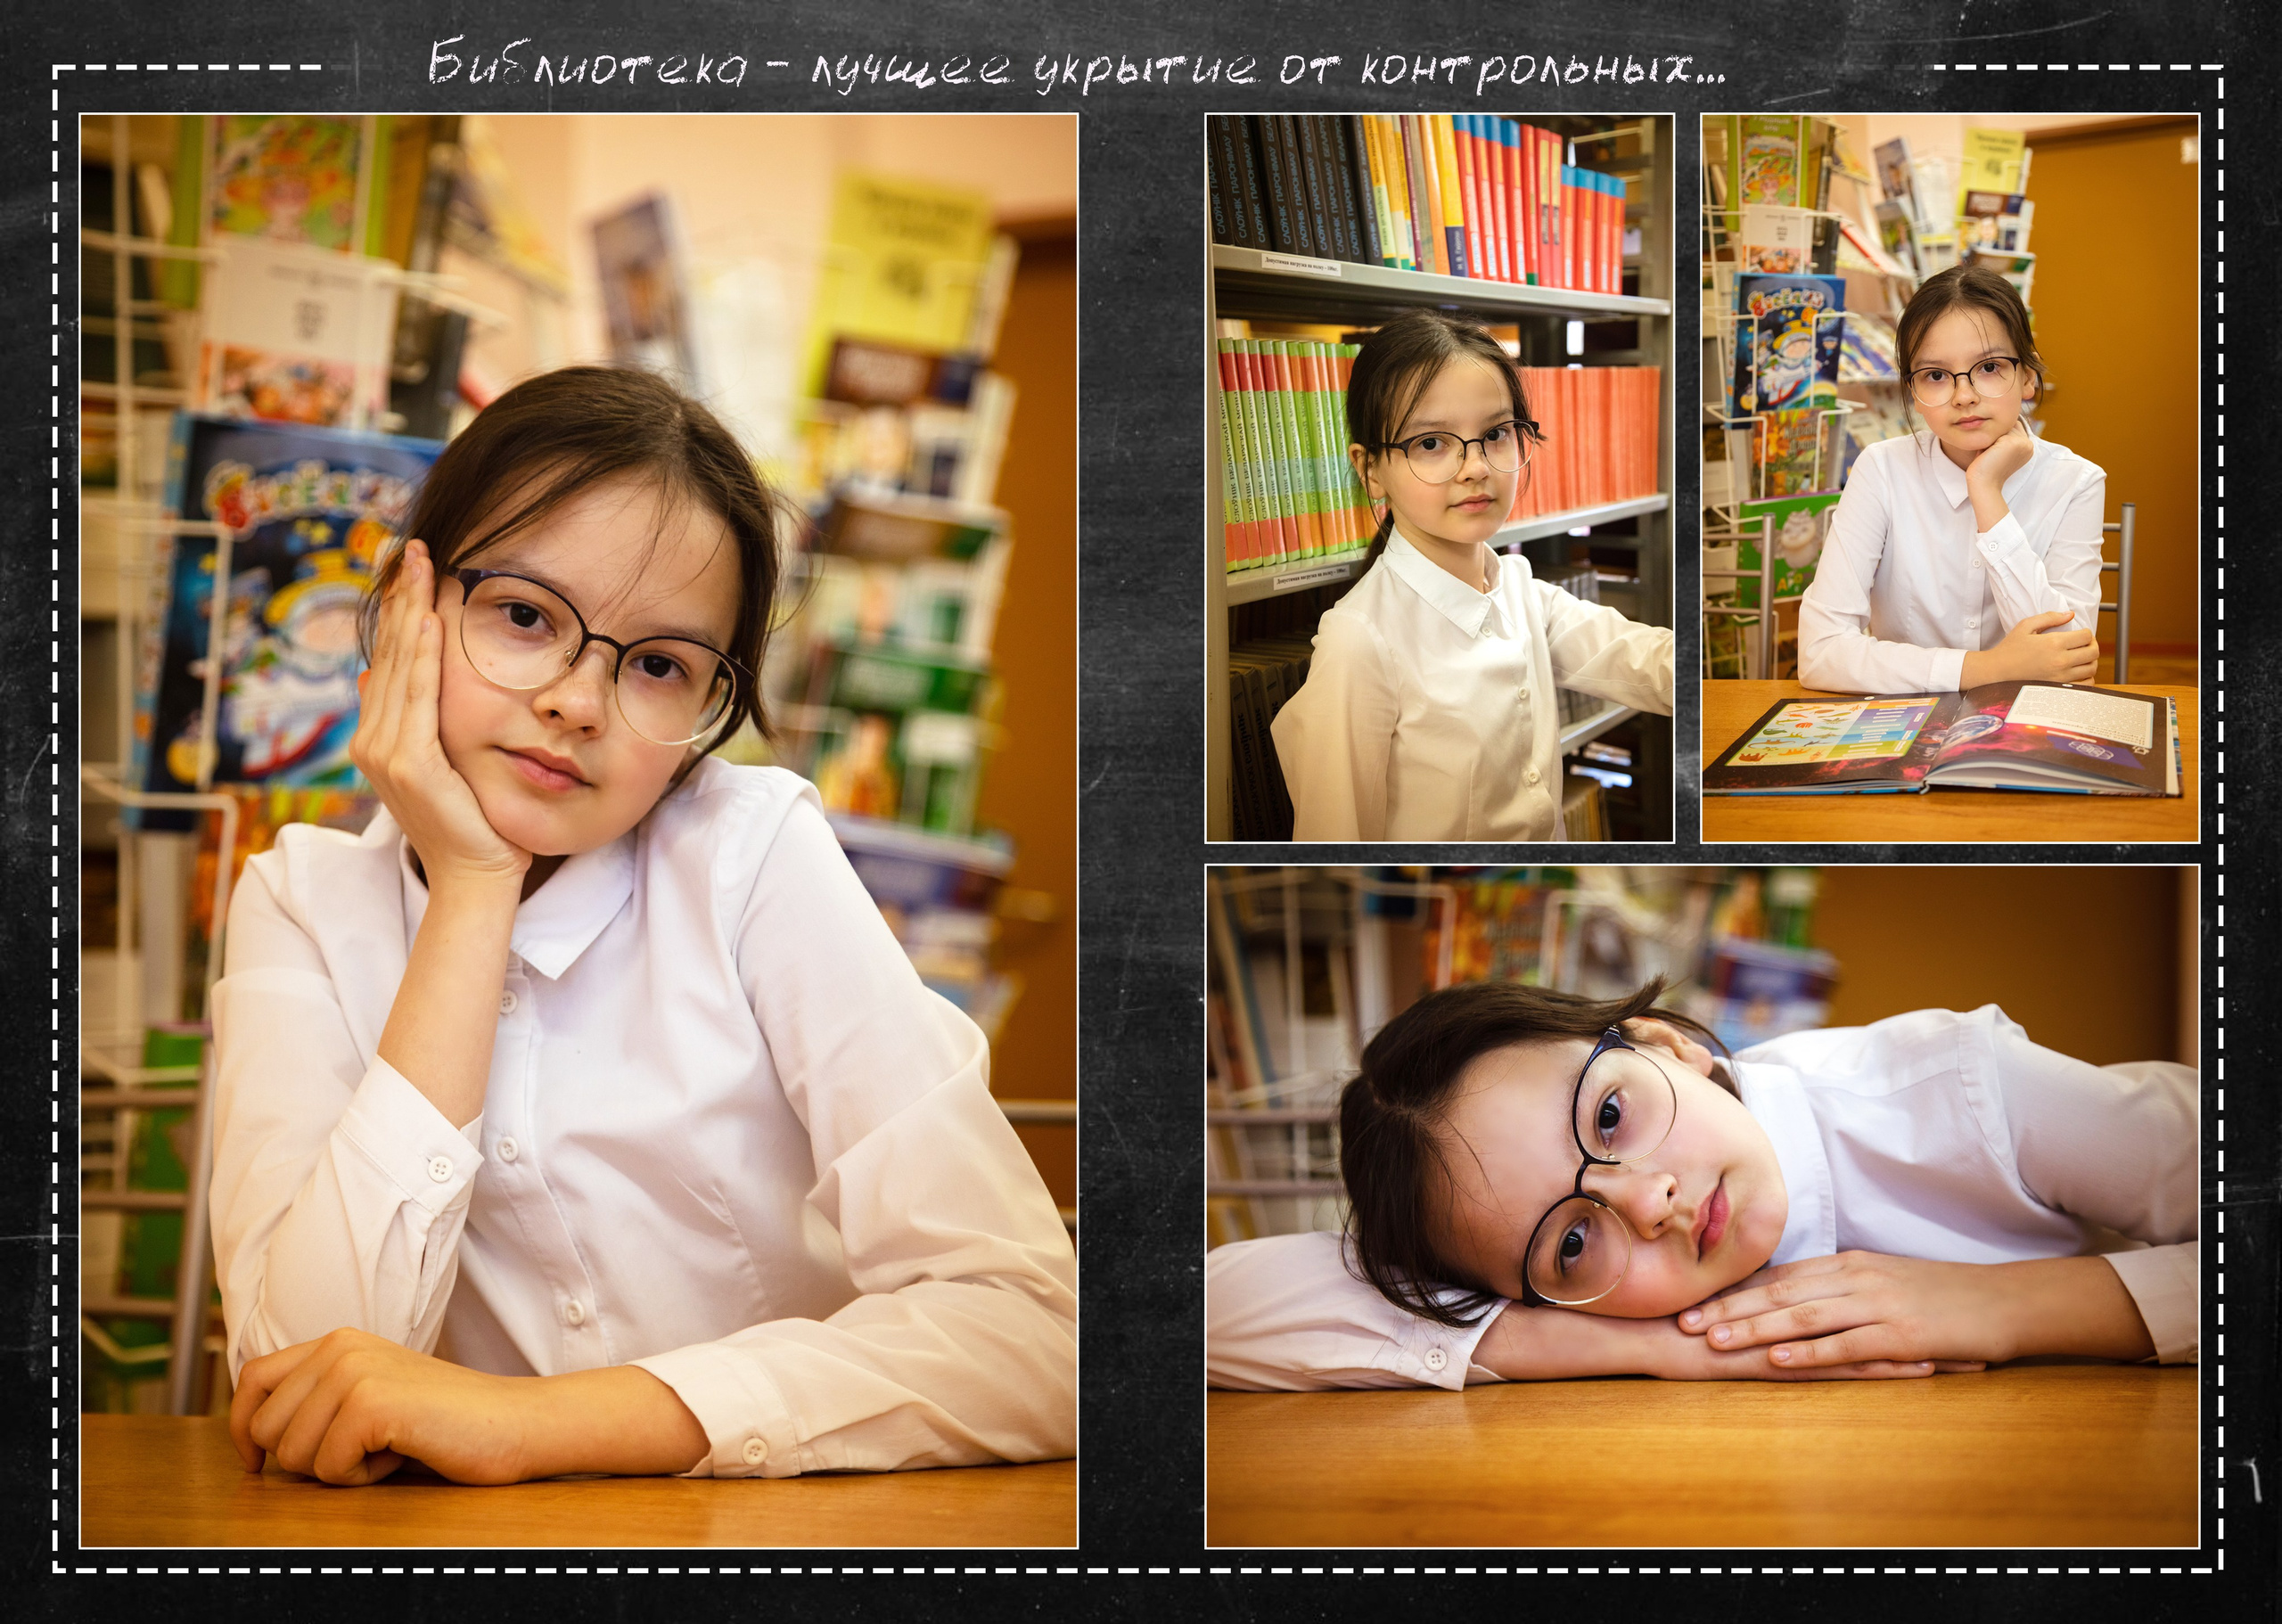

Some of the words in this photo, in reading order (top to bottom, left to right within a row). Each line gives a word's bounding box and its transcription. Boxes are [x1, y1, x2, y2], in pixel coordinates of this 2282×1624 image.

[1223, 423, 1235, 480] БЕЛАРУСКАЙ
[1237, 422, 1249, 479] БЕЛАРУСКАЙ
[1250, 422, 1261, 477] БЕЛАРУСКАЙ
[1276, 422, 1286, 475] БЕЛАРУСКАЙ
[1232, 483, 1240, 522] СЛОЎНІК
[1259, 480, 1267, 519] СЛОЎНІК
[1284, 479, 1292, 515] СЛОЎНІК
